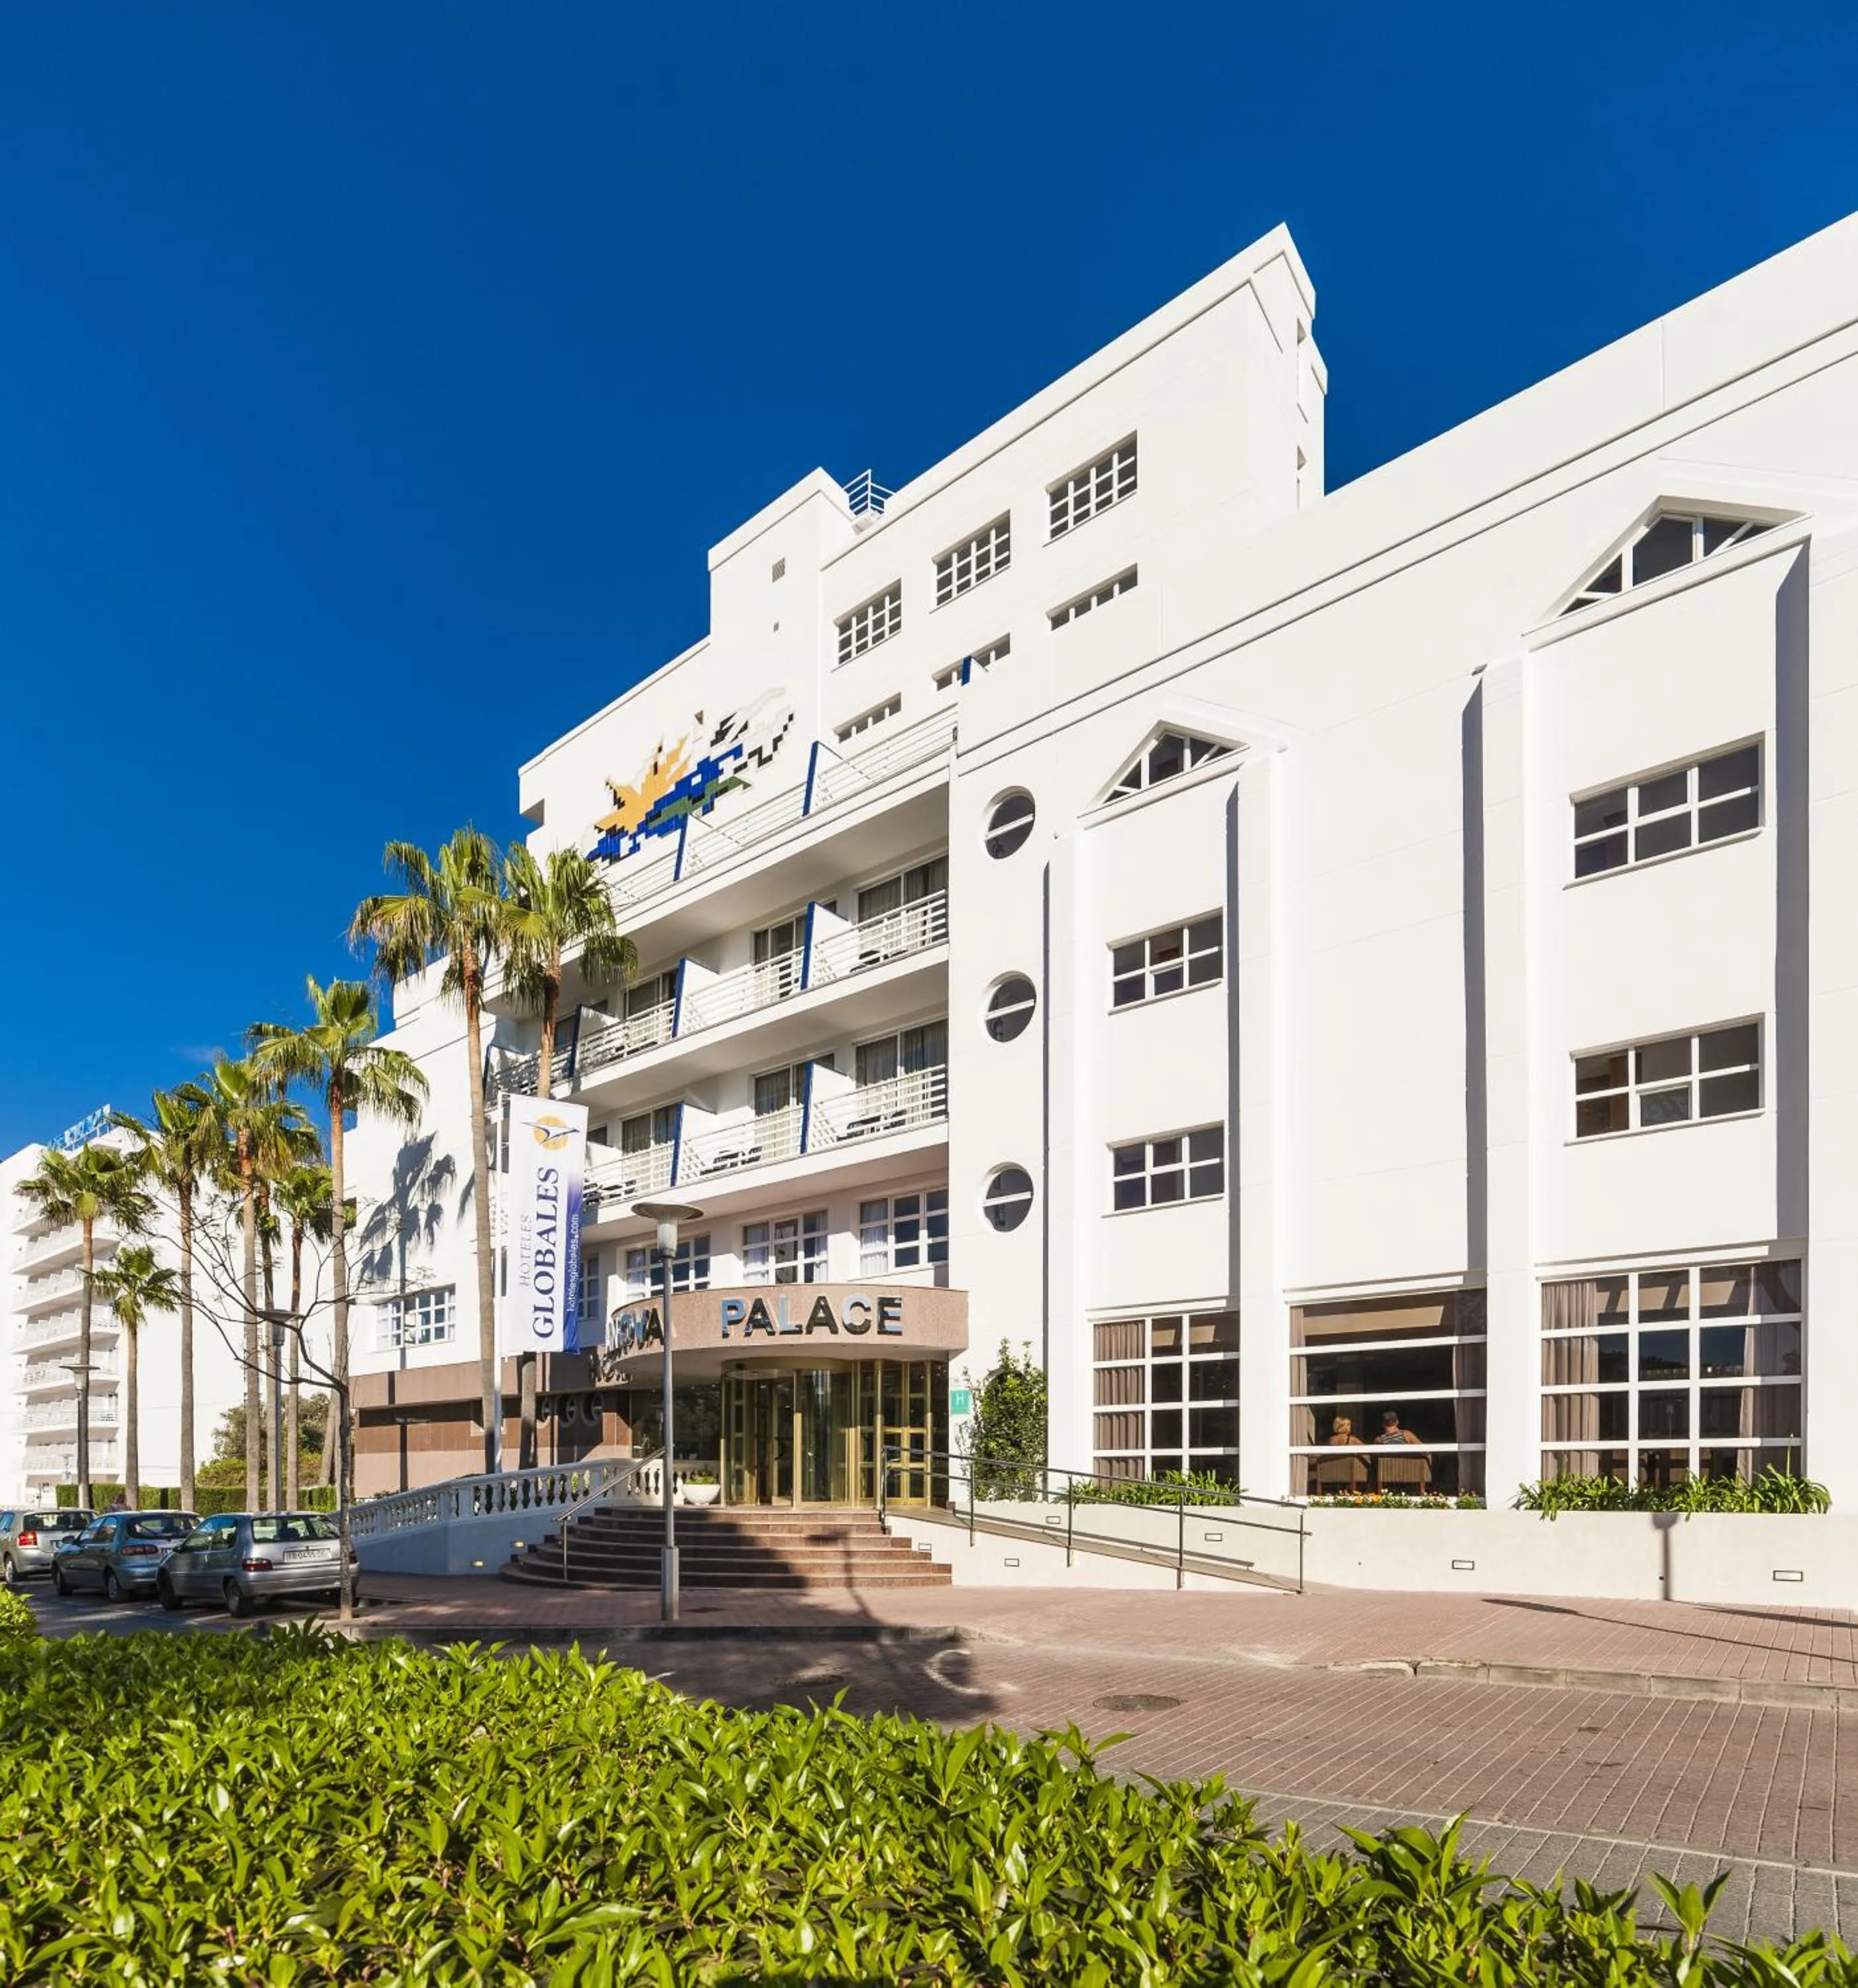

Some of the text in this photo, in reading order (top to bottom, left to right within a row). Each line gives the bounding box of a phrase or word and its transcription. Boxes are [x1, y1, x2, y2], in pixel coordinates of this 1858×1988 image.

[519, 1213, 532, 1287] HOTELES
[532, 1166, 559, 1339] GLOBALES
[566, 1213, 580, 1313] hotelesglobales.com
[721, 1294, 903, 1339] PALACE
[956, 1391, 965, 1406] H
